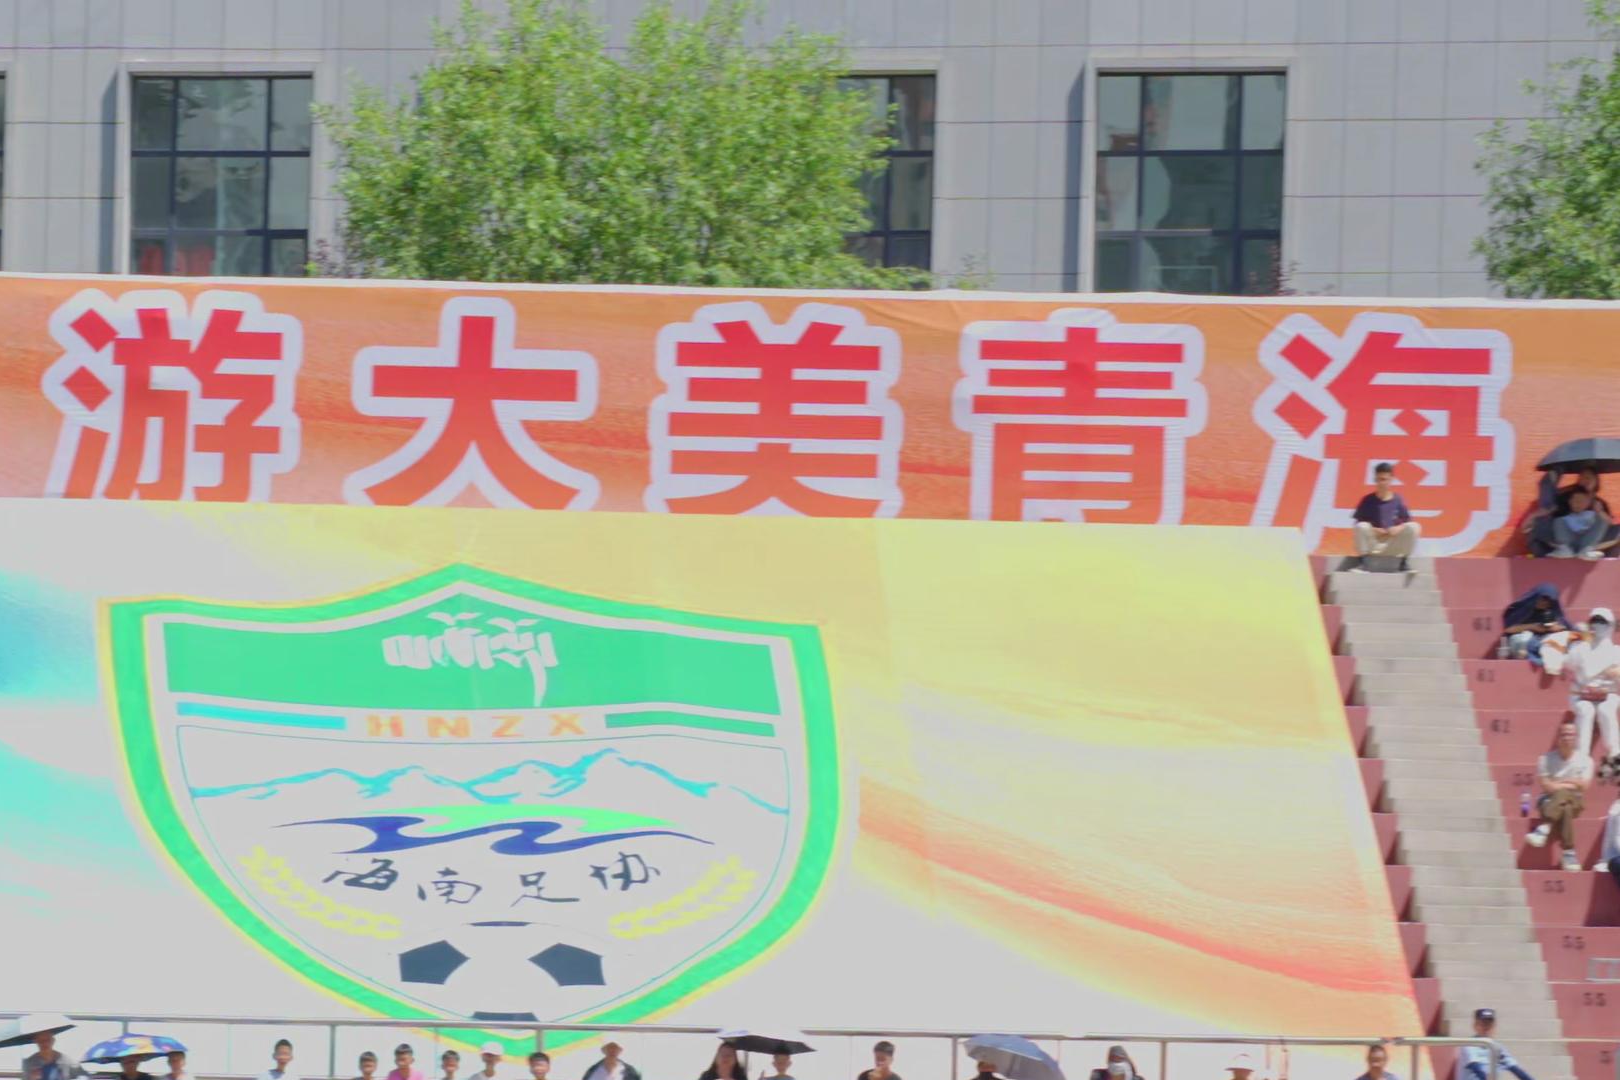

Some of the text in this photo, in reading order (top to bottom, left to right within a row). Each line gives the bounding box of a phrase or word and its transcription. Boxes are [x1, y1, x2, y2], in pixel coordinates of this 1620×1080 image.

[366, 711, 586, 739] HNZX
[324, 851, 661, 909] 海南足协
